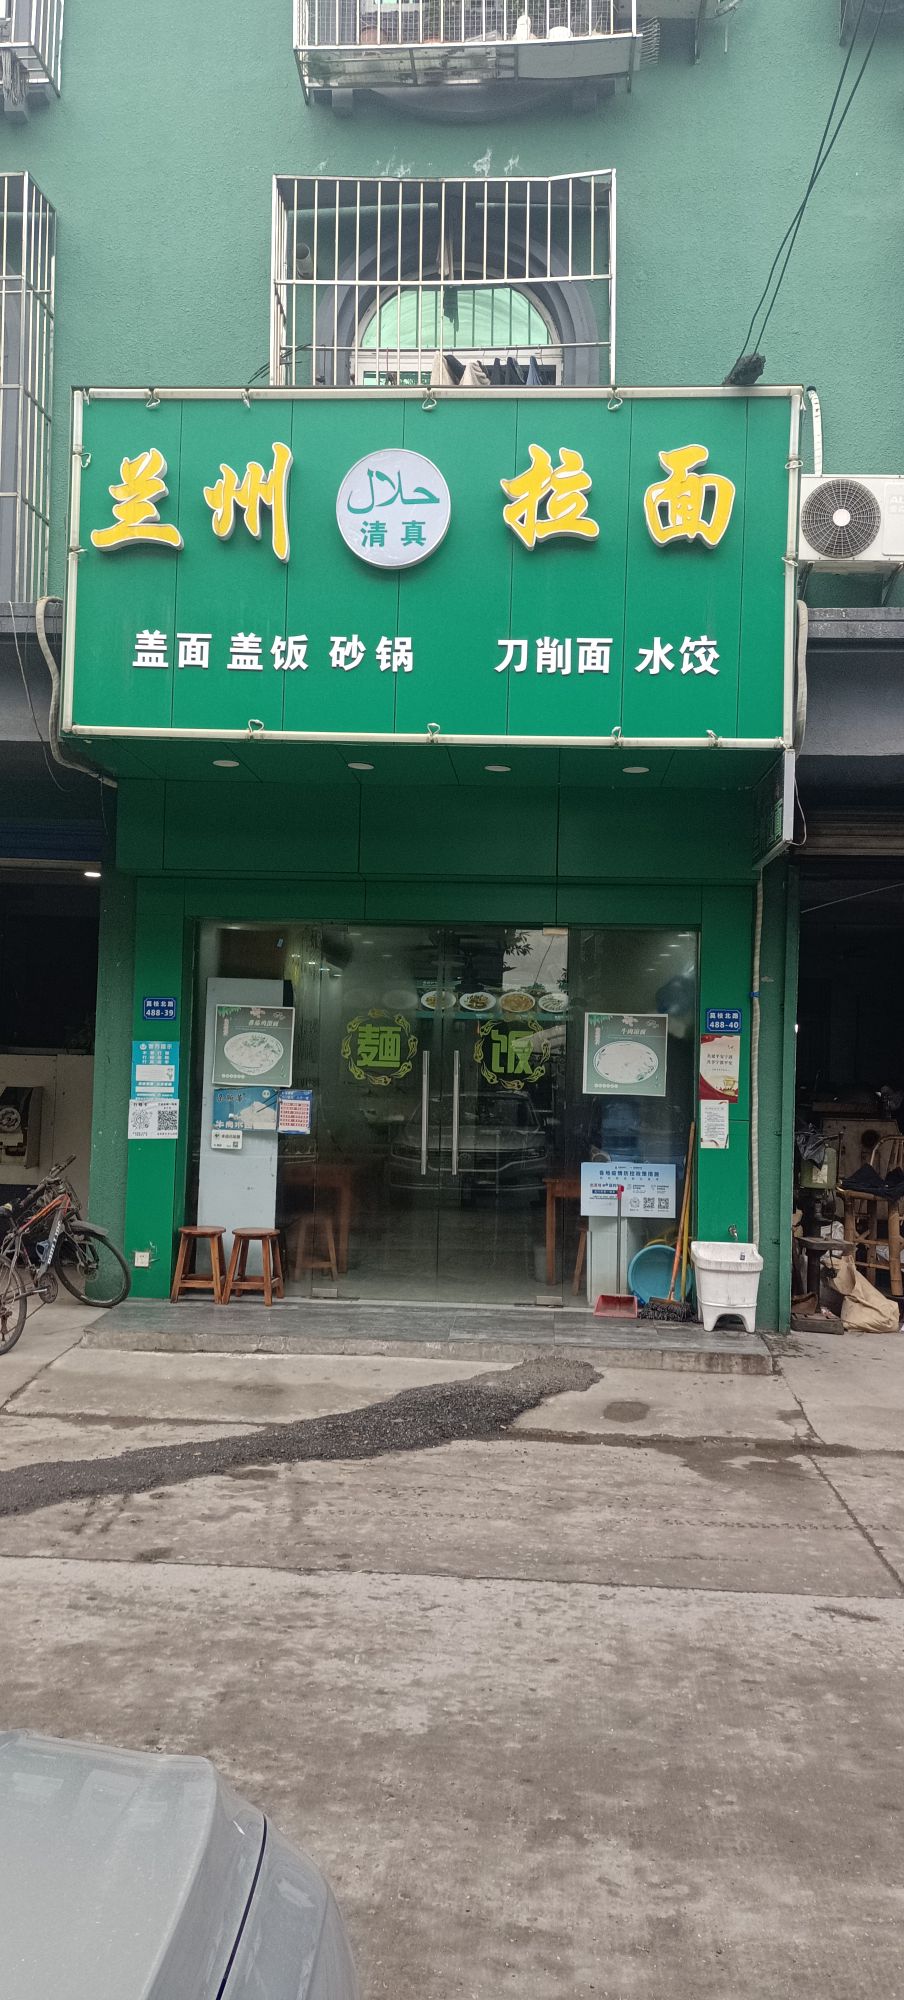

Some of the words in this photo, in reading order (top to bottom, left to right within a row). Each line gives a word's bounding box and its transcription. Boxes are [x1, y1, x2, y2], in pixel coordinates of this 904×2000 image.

[90, 442, 293, 562] 兰州
[500, 443, 736, 551] 拉面
[347, 468, 440, 514] حلال
[360, 520, 427, 547] 清真
[132, 629, 213, 669] 盖面
[226, 632, 308, 671] 盖饭
[328, 634, 414, 673] 砂锅
[494, 636, 613, 675] 刀削面
[634, 635, 720, 675] 水饺
[145, 1009, 174, 1017] 488-39
[709, 1021, 739, 1029] 488-40
[357, 1024, 402, 1068] 麵
[490, 1029, 534, 1074] 饭
